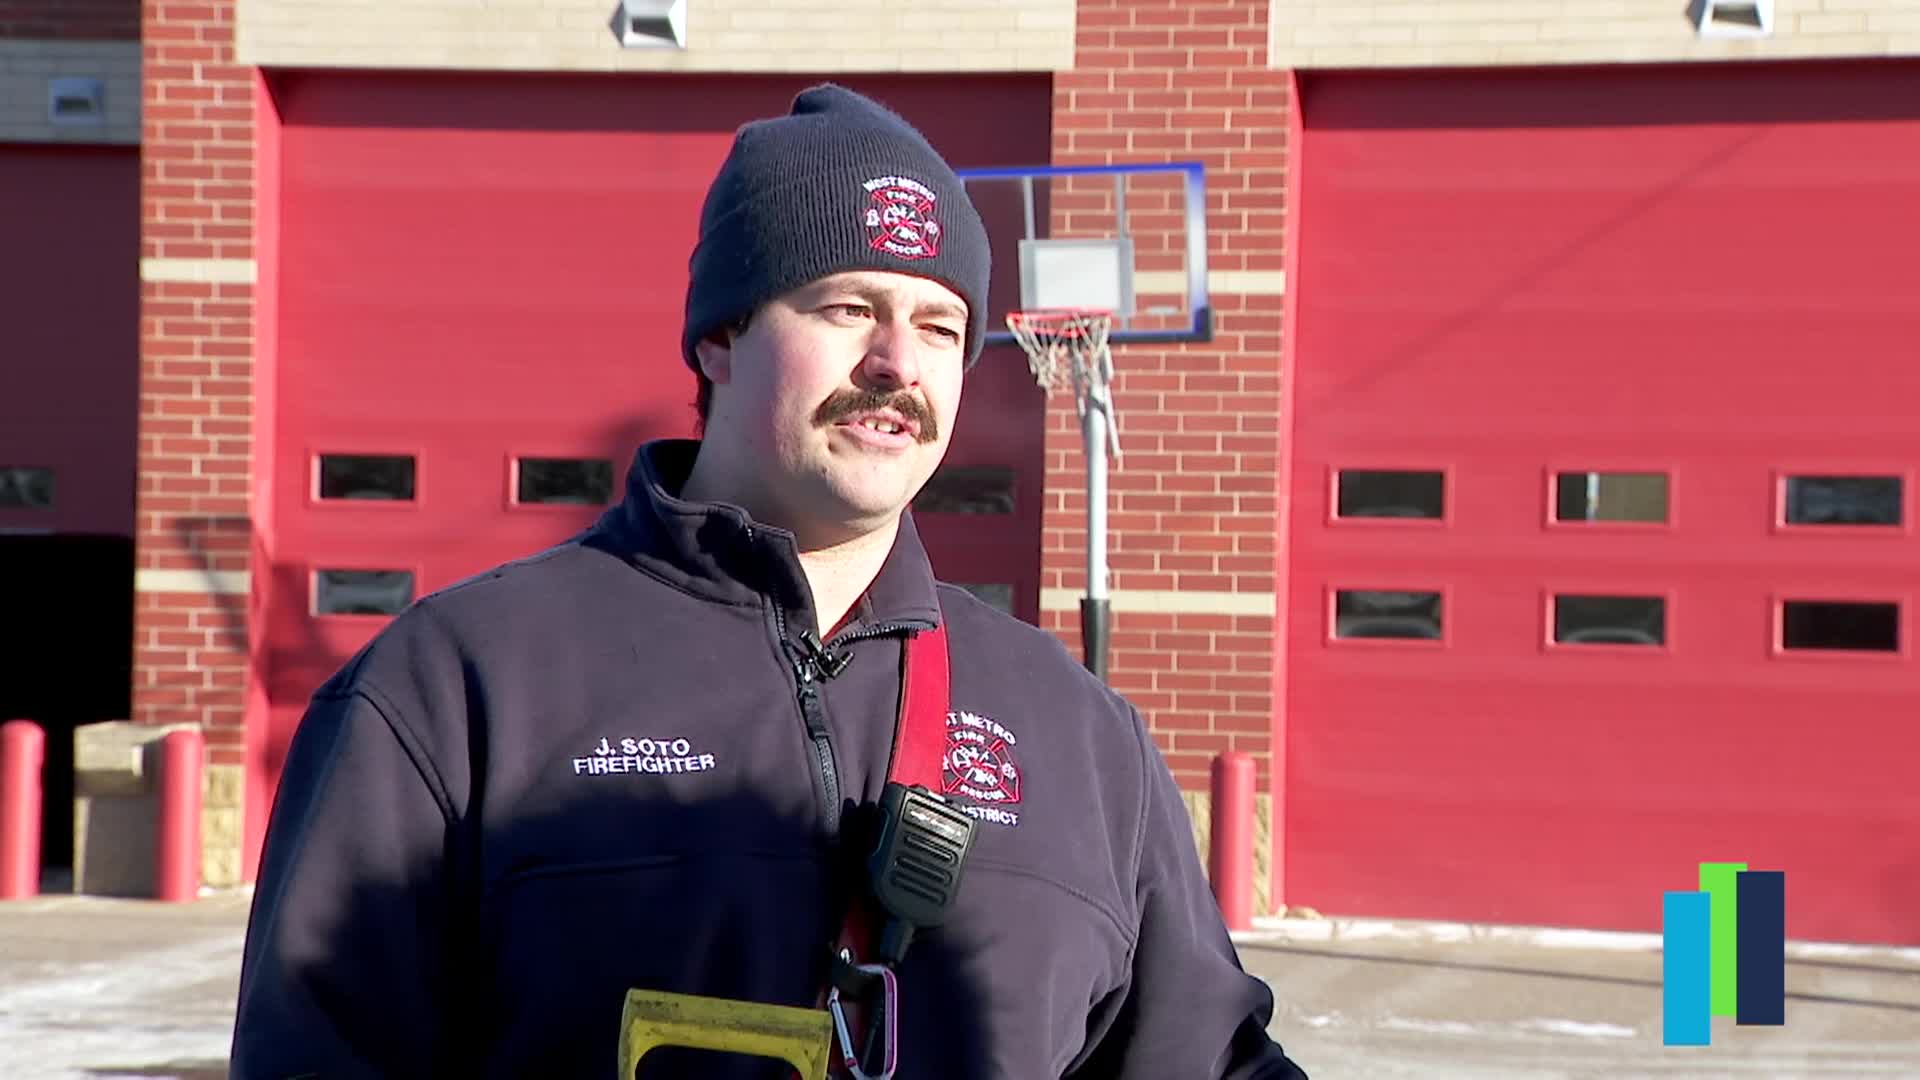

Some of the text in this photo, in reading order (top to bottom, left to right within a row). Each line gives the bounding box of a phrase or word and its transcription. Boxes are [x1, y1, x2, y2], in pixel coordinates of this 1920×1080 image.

[953, 730, 985, 745] FIRE
[961, 711, 1016, 745] METRO
[595, 737, 691, 756] J. SOTO
[573, 753, 716, 775] FIREFIGHTER
[961, 804, 1019, 826] STRICT
